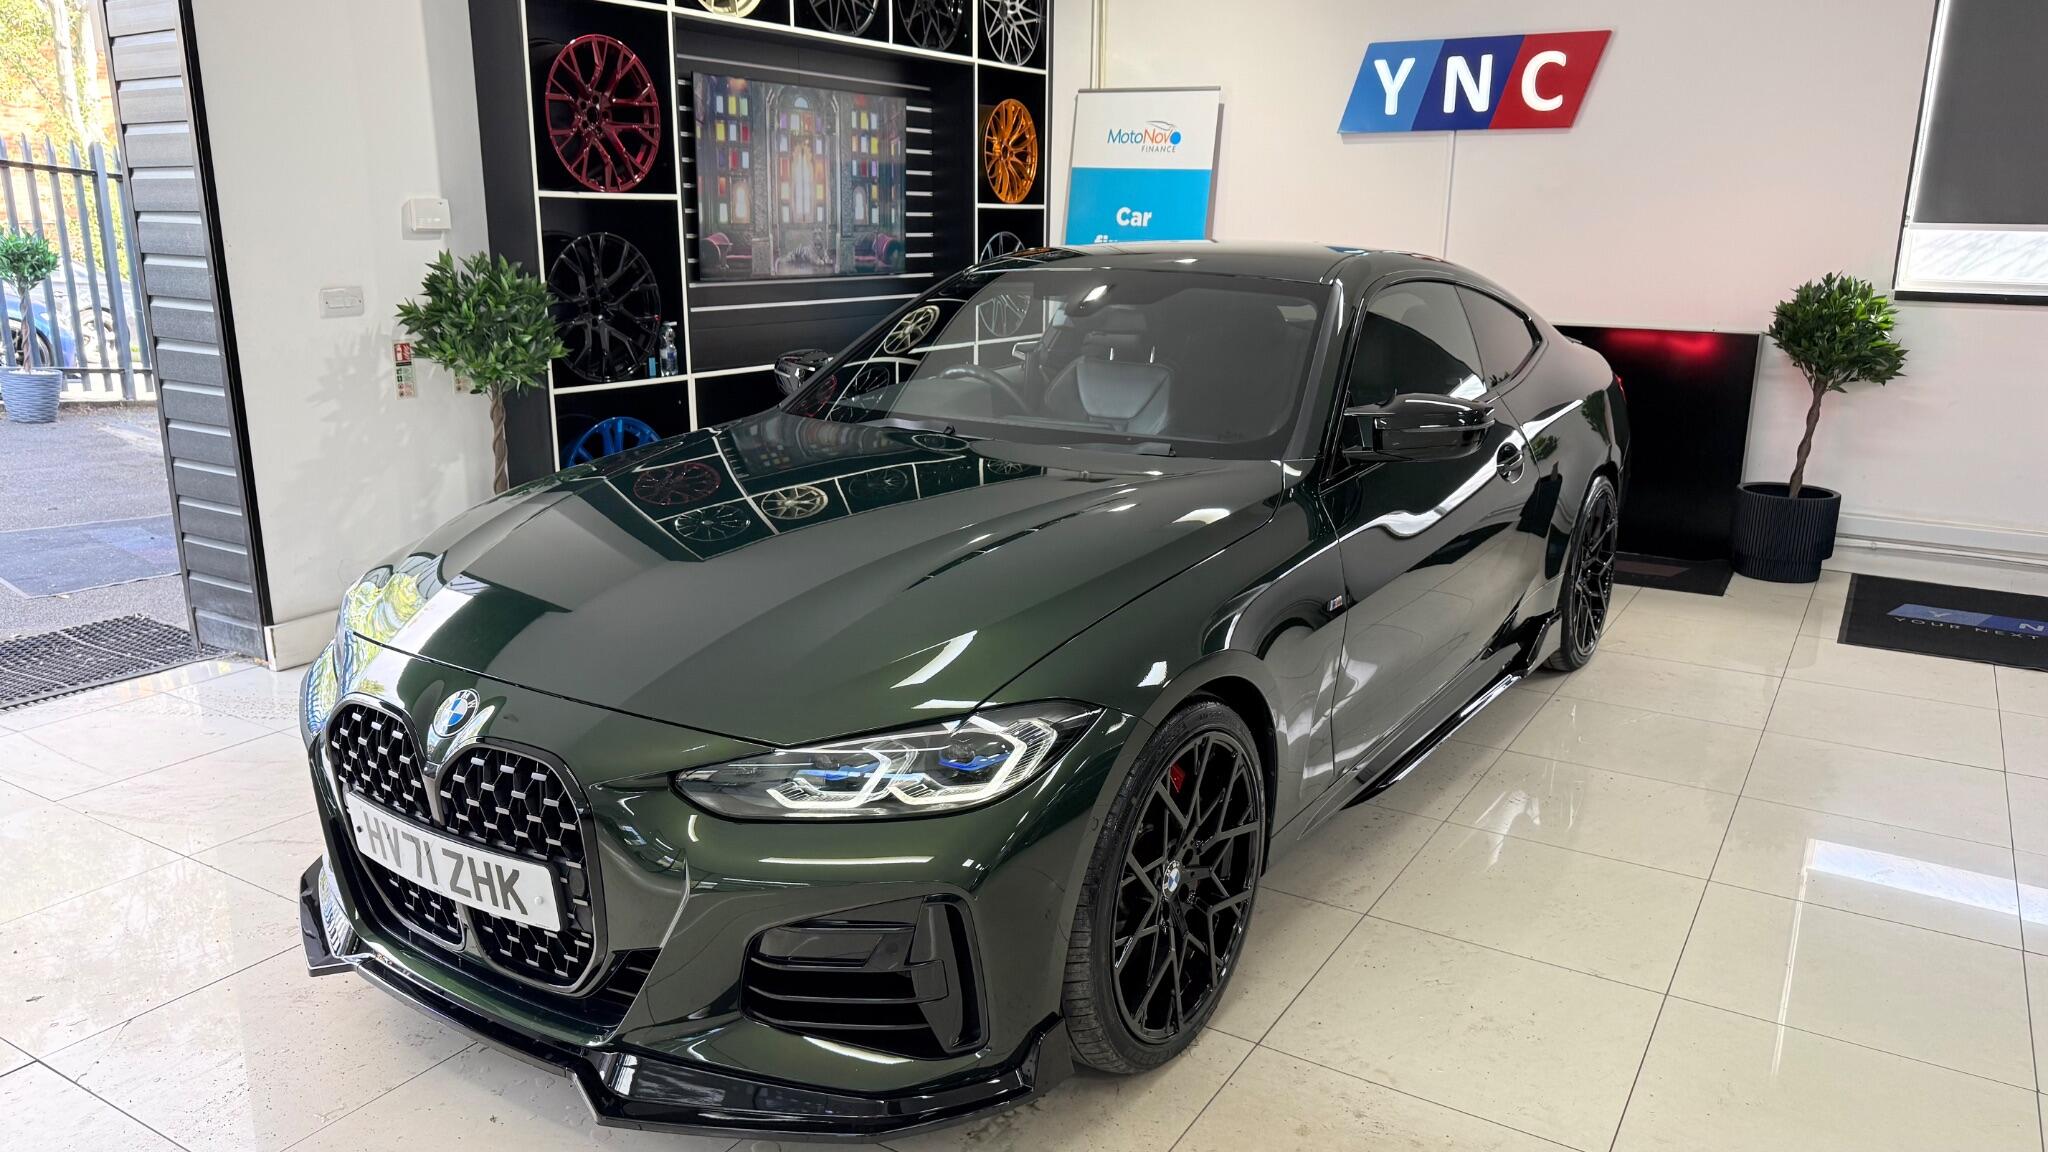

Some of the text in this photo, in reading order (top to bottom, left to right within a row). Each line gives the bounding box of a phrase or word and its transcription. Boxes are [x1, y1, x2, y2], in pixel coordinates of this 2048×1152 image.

[1373, 50, 1567, 116] YNC
[1141, 144, 1177, 153] FINANCE
[1115, 206, 1152, 227] Car
[1894, 617, 2039, 640] YOUR NEXT
[363, 811, 528, 916] HV71 ZHK
